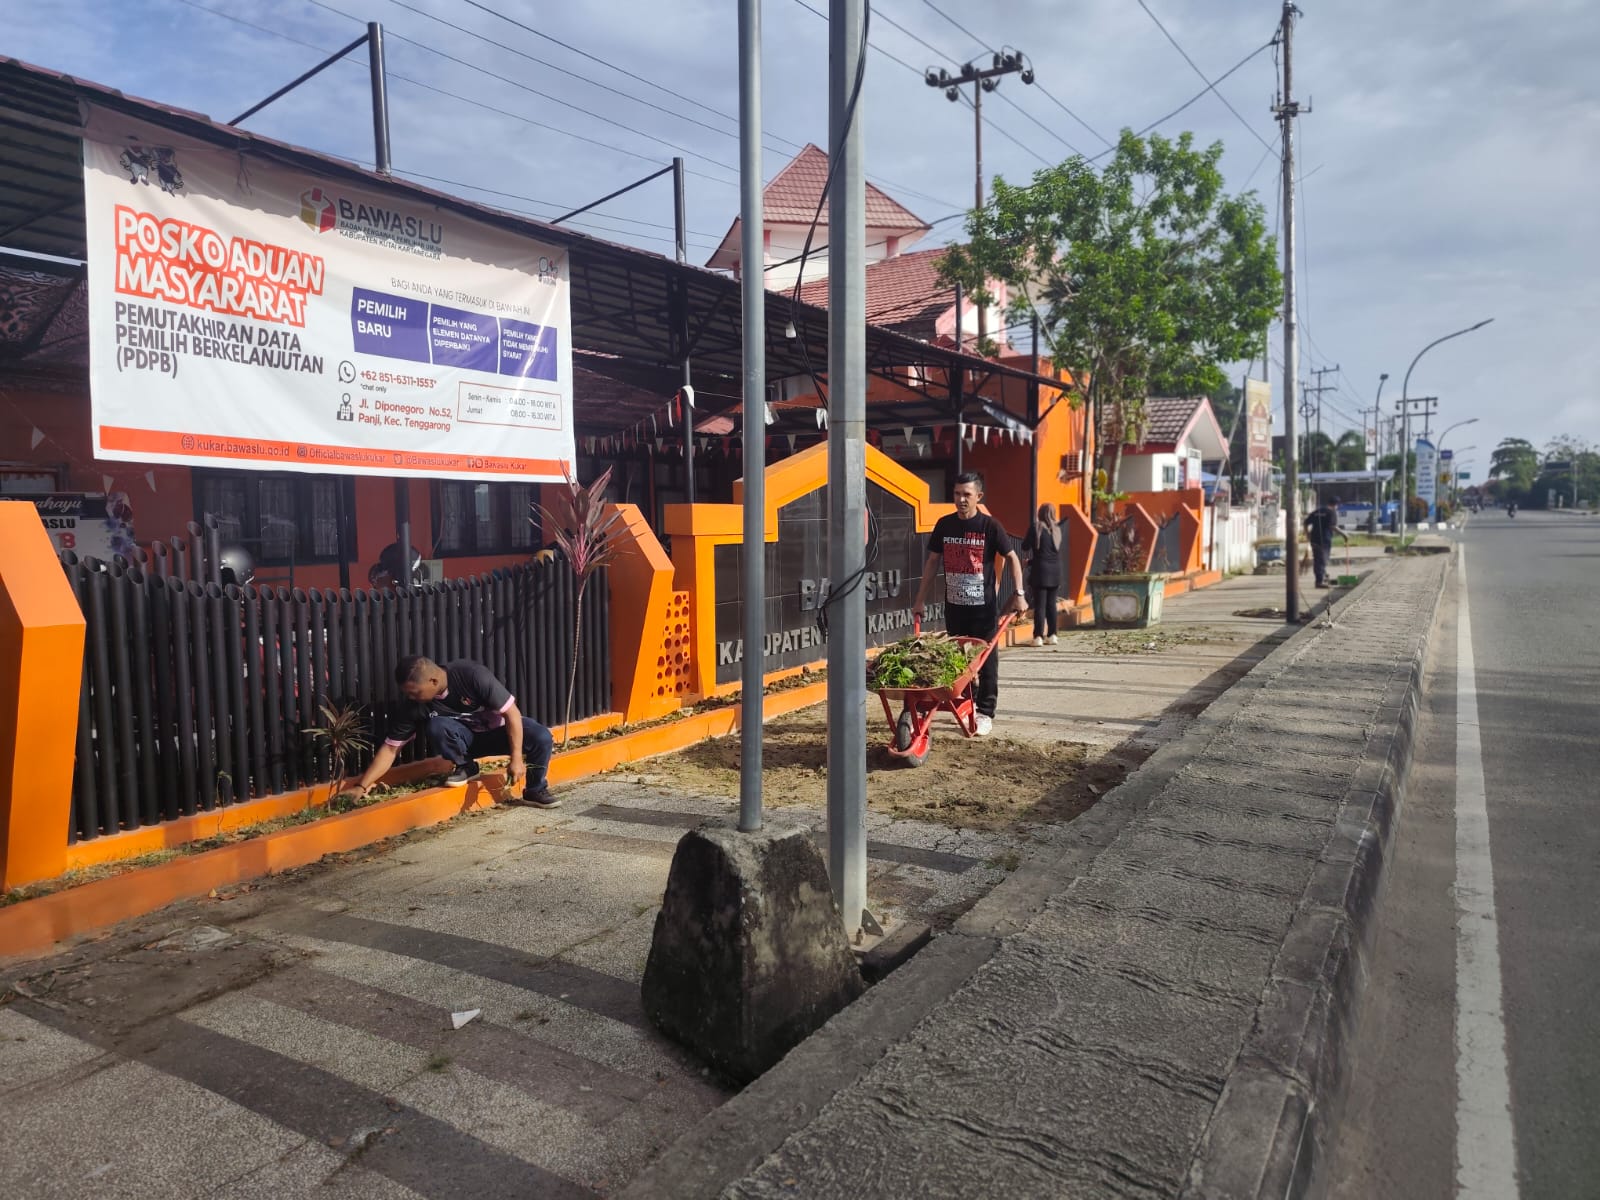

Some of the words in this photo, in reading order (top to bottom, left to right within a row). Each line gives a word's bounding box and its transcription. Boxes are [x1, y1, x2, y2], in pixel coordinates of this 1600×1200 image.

[338, 198, 443, 244] BAWASLU
[340, 221, 362, 231] BADAN
[116, 206, 226, 269] POSKO
[231, 240, 323, 292] ADUAN
[339, 230, 378, 244] KABUPATEN
[379, 240, 397, 250] KUTAI
[117, 252, 306, 324] MASYARARAT
[391, 277, 410, 291] BAGI
[411, 283, 433, 296] ANDA
[434, 287, 454, 301] YANG
[455, 291, 487, 308] TERMASUK
[488, 299, 495, 309] DI
[496, 301, 523, 314] BAWAH
[357, 299, 407, 321] PEMILIH
[115, 301, 253, 345] PEMUTAKHIRAN
[257, 328, 301, 351] DATA
[357, 319, 392, 338] BARU
[433, 316, 458, 327] PEMILIH
[459, 321, 478, 331] YANG
[432, 328, 460, 339] ELEMEN
[460, 332, 491, 344] DATANYA
[503, 329, 524, 339] PEMILIH
[116, 324, 188, 354] PEMILIH
[192, 336, 323, 374] BERKELANJUTAN
[433, 339, 471, 352] DIPERBAIKI
[502, 340, 518, 350] TIDAK
[502, 350, 522, 360] SYARAT
[116, 346, 178, 379] (PDPB)
[360, 370, 377, 382] +62
[375, 384, 387, 394] only
[358, 398, 369, 409] Jl.
[374, 400, 424, 416] Diponegoro
[429, 406, 453, 420] No.52,
[358, 413, 382, 427] Panji,
[384, 415, 402, 427] Kec.
[404, 417, 451, 432] Tenggarong
[801, 569, 901, 611] BASLU
[719, 625, 821, 666] KAUPATEN
[868, 601, 945, 634] KARTANGAR
